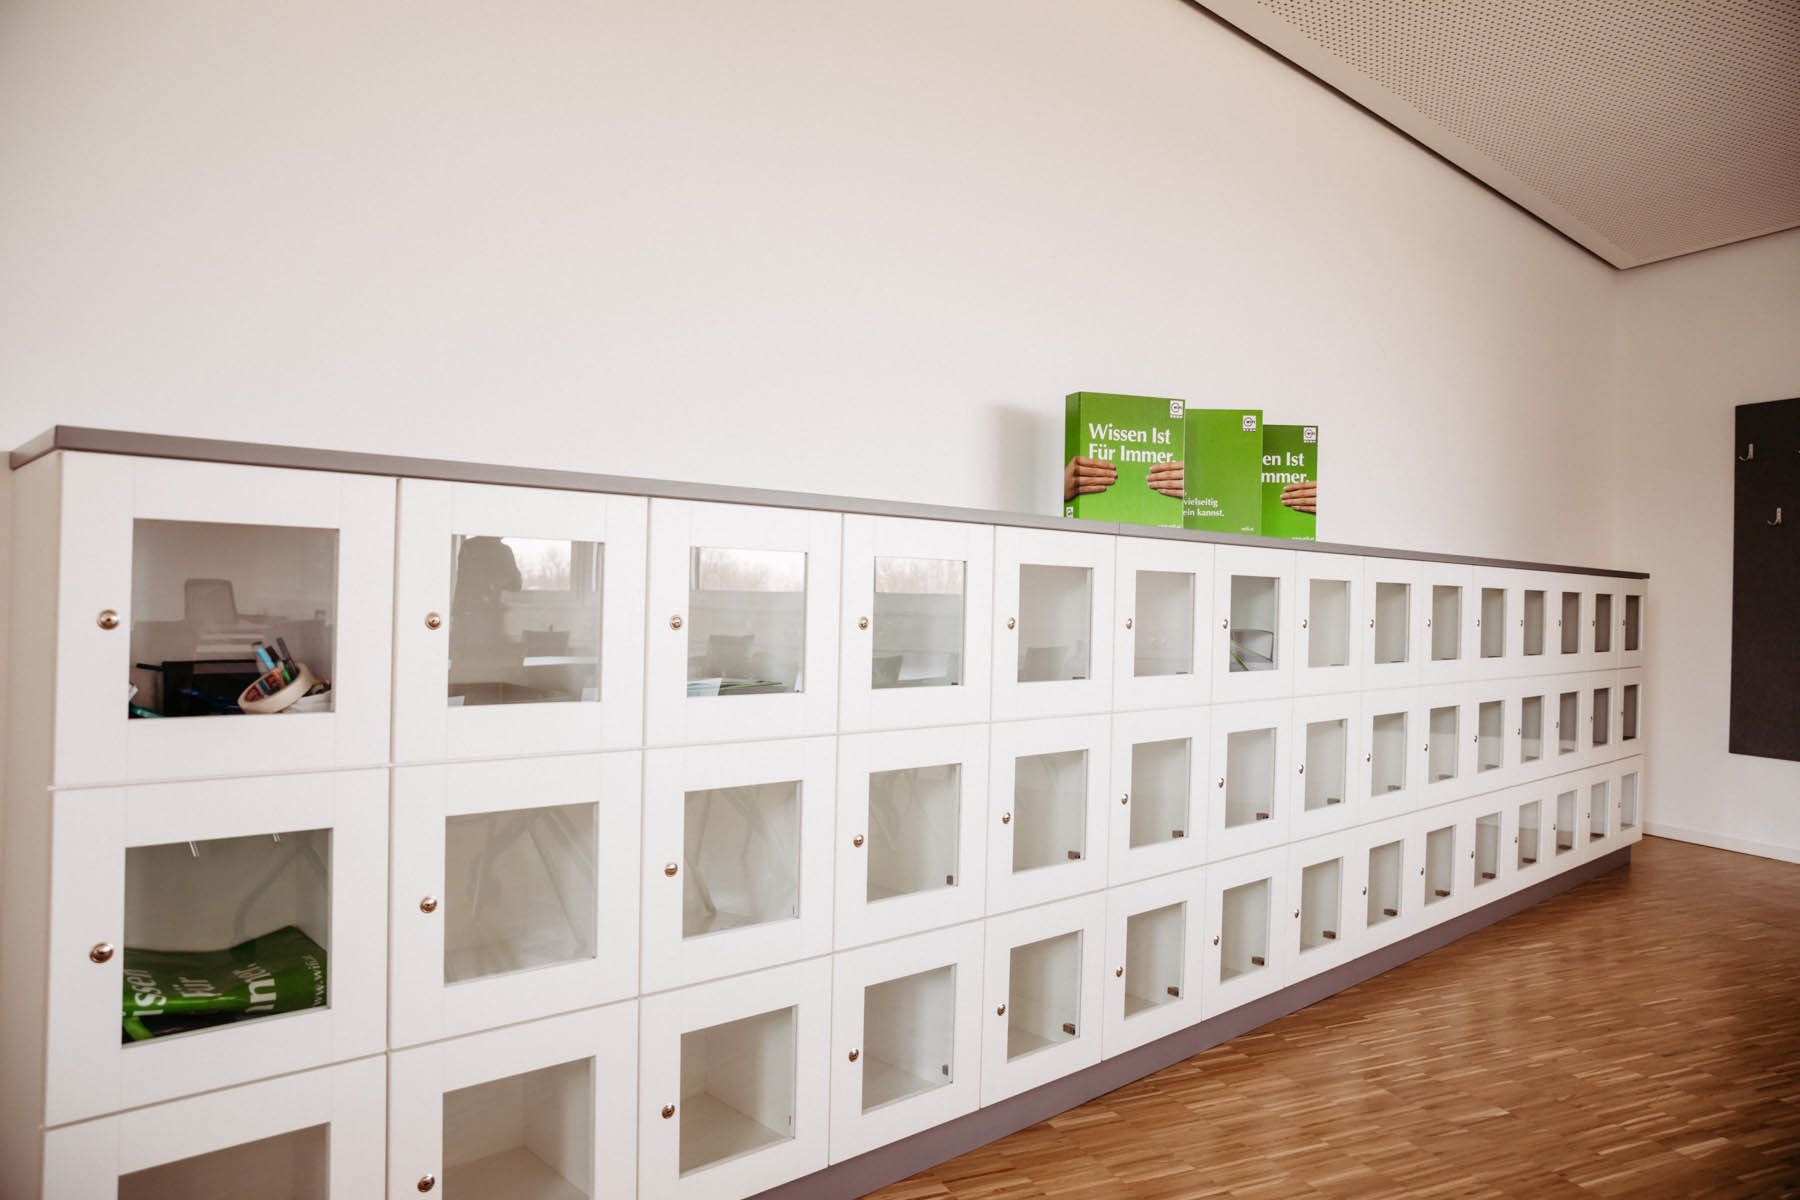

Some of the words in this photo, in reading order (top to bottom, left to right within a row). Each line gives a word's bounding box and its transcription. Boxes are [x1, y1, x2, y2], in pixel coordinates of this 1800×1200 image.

[1088, 422, 1147, 443] Wissen
[1152, 427, 1171, 445] Ist
[1088, 443, 1116, 461] Für
[1120, 446, 1177, 463] Immer.
[1286, 451, 1305, 466] Ist
[1261, 472, 1310, 484] mmer.
[1183, 508, 1195, 516] ein
[123, 968, 167, 1016] issen
